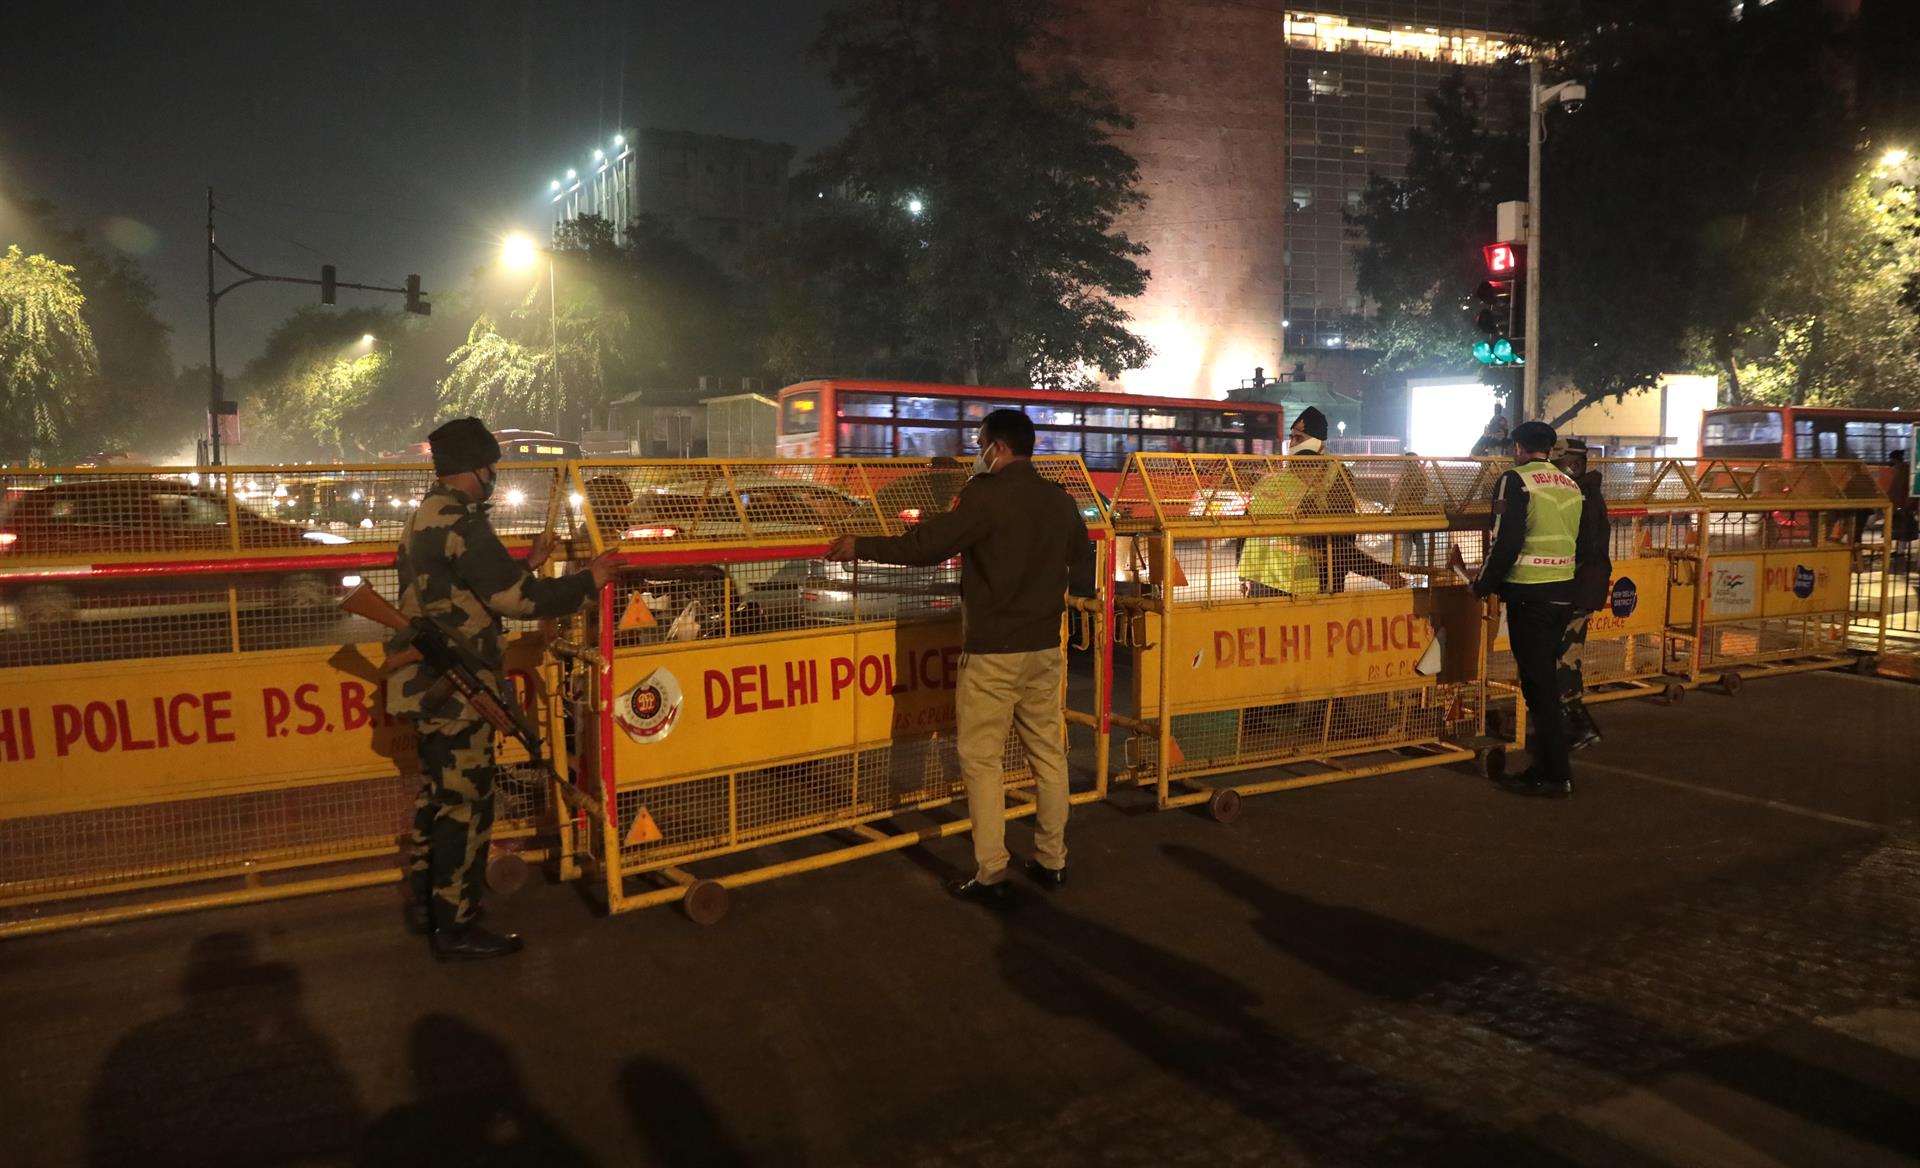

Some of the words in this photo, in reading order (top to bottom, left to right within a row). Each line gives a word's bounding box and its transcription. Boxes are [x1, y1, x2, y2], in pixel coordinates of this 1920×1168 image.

[1214, 624, 1311, 669] DELHI
[1326, 613, 1421, 658] POLICE
[704, 659, 818, 720] DELHI
[830, 646, 963, 701] POLICE
[52, 691, 237, 757] POLICE
